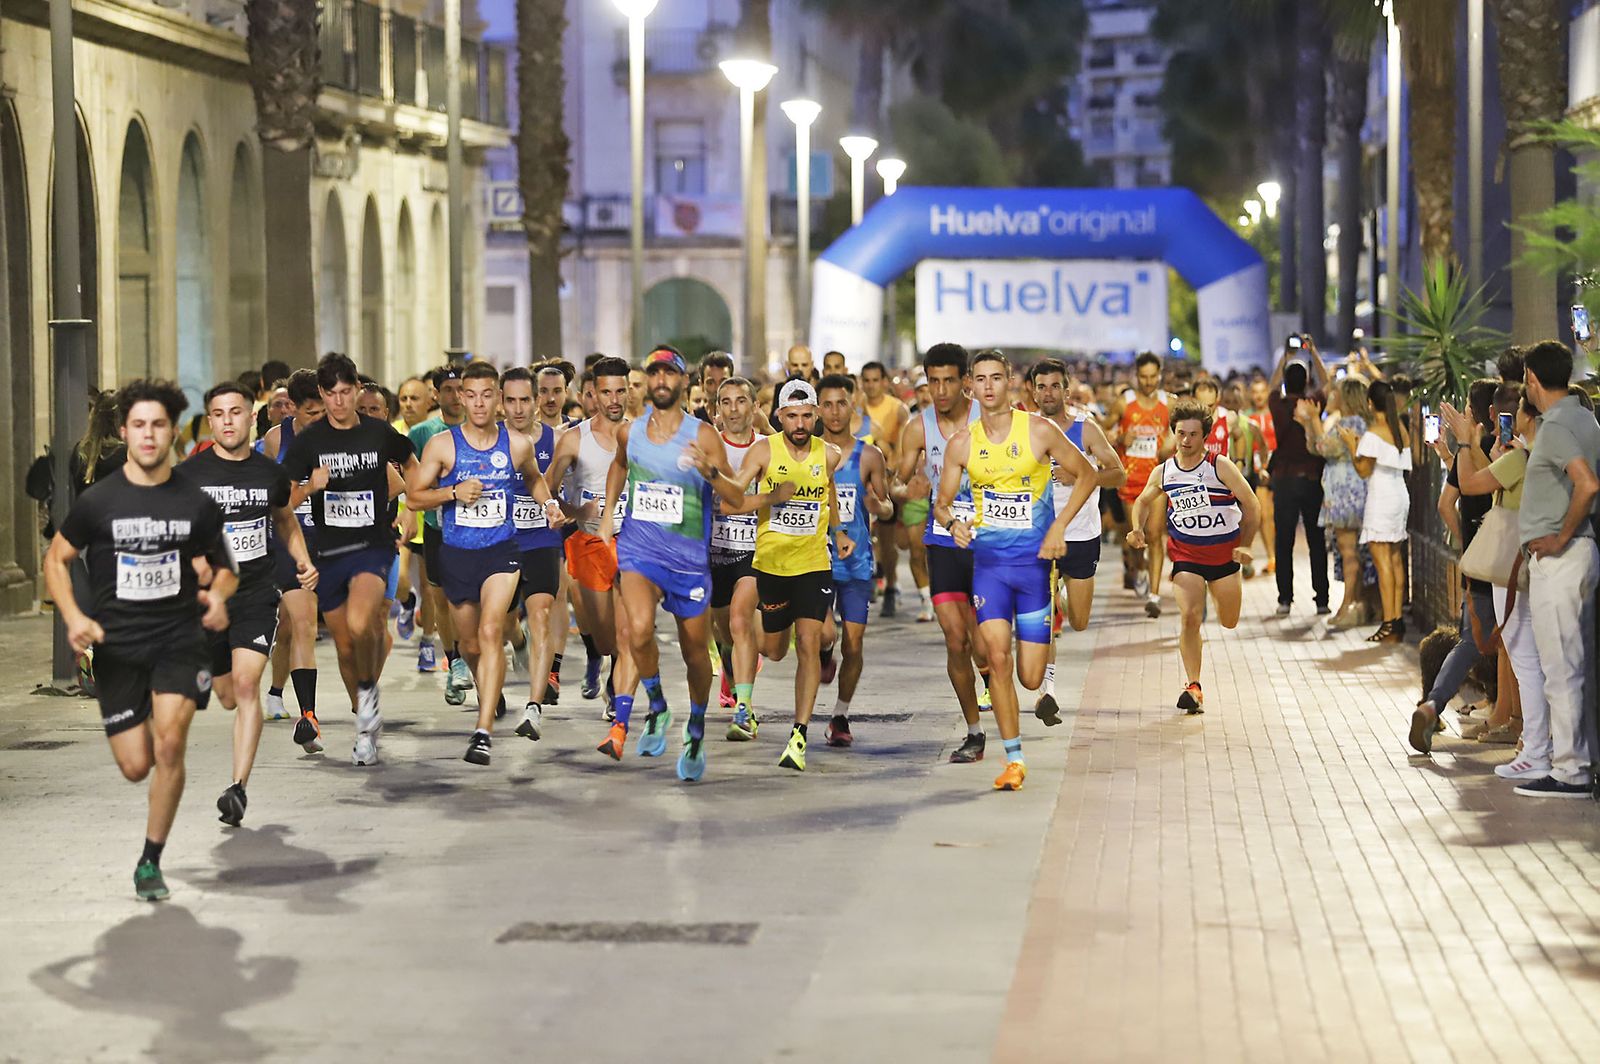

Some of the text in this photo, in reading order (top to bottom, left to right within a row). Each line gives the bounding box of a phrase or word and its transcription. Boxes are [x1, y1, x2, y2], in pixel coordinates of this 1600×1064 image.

[935, 266, 1130, 317] Huelva
[362, 451, 379, 467] FUN
[249, 488, 268, 502] FUN
[337, 504, 360, 518] 604
[474, 504, 488, 518] 13
[645, 497, 668, 512] 646
[1181, 497, 1198, 510] 303
[514, 507, 535, 520] 476
[782, 512, 807, 526] 655
[994, 504, 1017, 519] 249
[1172, 513, 1227, 529] CODA
[724, 525, 746, 541] 111
[232, 534, 257, 551] 366
[136, 570, 165, 587] 198
